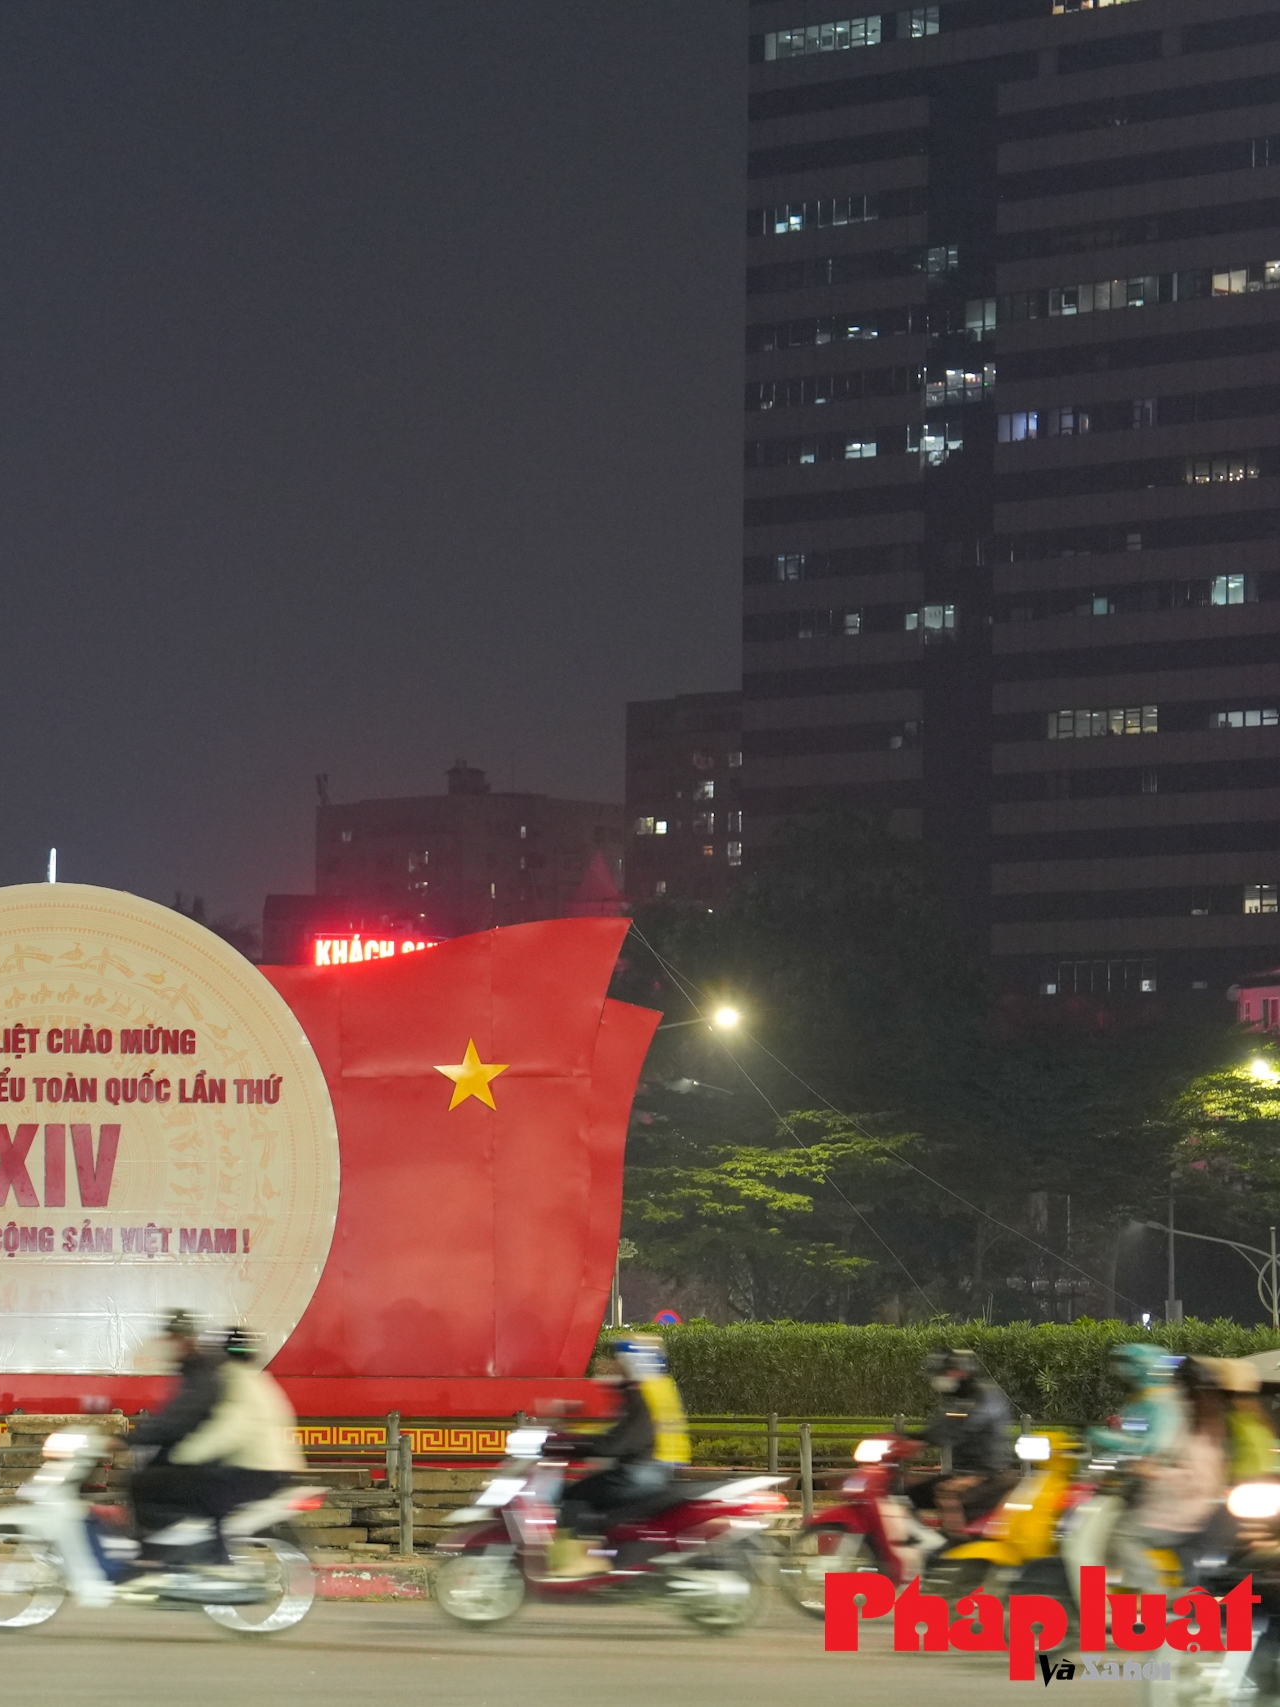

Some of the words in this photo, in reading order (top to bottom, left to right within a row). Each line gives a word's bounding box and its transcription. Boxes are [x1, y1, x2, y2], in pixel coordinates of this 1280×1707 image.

[316, 934, 395, 966] KHÁCH
[46, 1023, 113, 1054] CHÀO
[120, 1023, 196, 1055] MỪNG
[32, 1071, 98, 1103] TOÀN
[105, 1068, 171, 1106] QUỐC
[178, 1069, 226, 1104] LẦN
[233, 1073, 283, 1104] THỨ
[62, 1218, 113, 1253] SẢN
[121, 1222, 173, 1259] VIỆT
[179, 1228, 237, 1253] NAM
